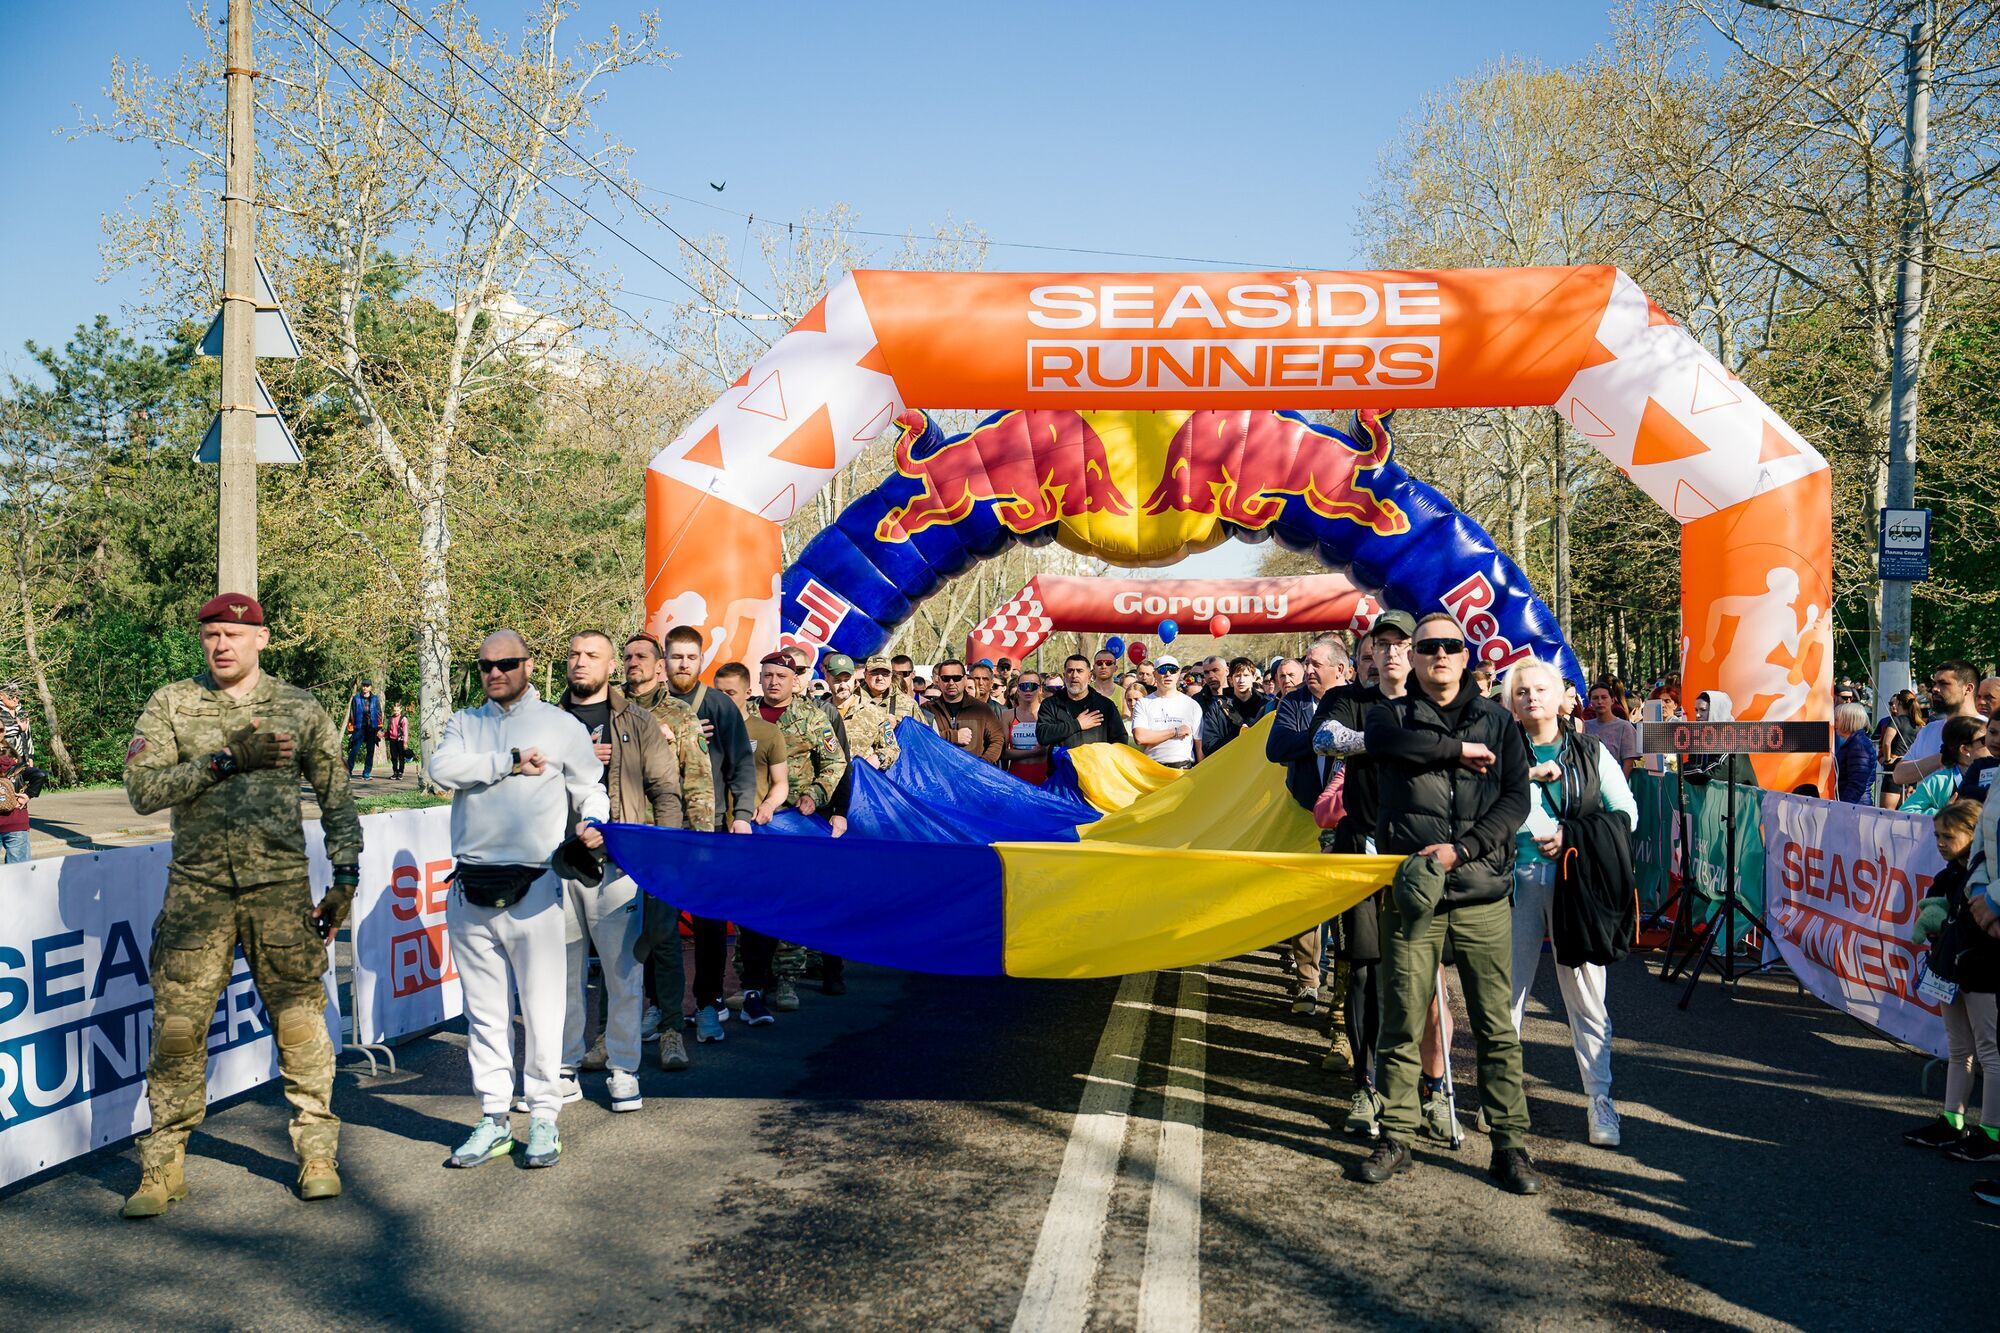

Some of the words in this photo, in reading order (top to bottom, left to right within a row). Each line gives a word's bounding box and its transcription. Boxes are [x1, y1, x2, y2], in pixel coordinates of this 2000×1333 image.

[1027, 276, 1441, 329] SEASIDE
[1031, 342, 1435, 388] RUNNERS
[1113, 591, 1289, 620] Gorgany
[1441, 572, 1533, 673] Red
[1674, 725, 1784, 750] 0:00:00
